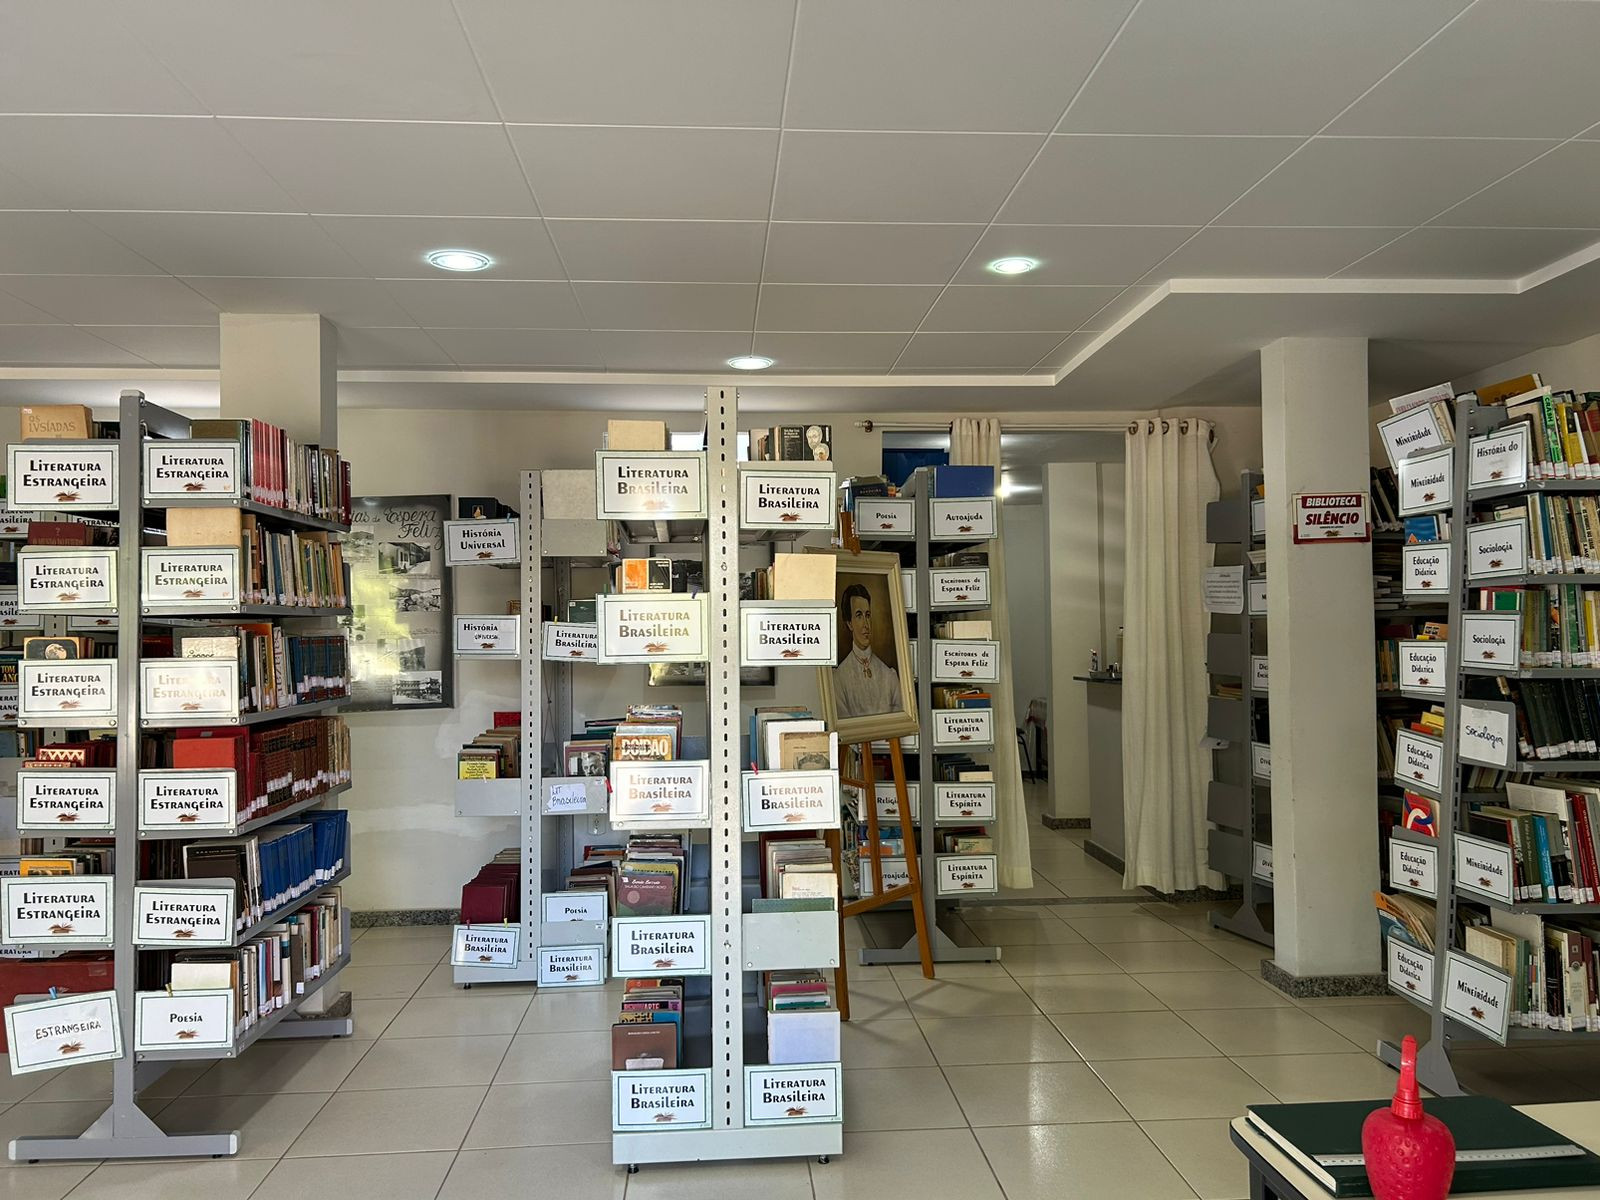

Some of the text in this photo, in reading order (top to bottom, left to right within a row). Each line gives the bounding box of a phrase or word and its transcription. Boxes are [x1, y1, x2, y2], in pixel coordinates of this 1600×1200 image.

[1508, 441, 1518, 452] do
[1306, 497, 1357, 506] BIBLIOTECA
[384, 506, 437, 526] Espera
[1305, 511, 1359, 525] SILÊNCIO
[398, 521, 443, 550] Feliz
[35, 1020, 102, 1040] ESTRANGEIRA
